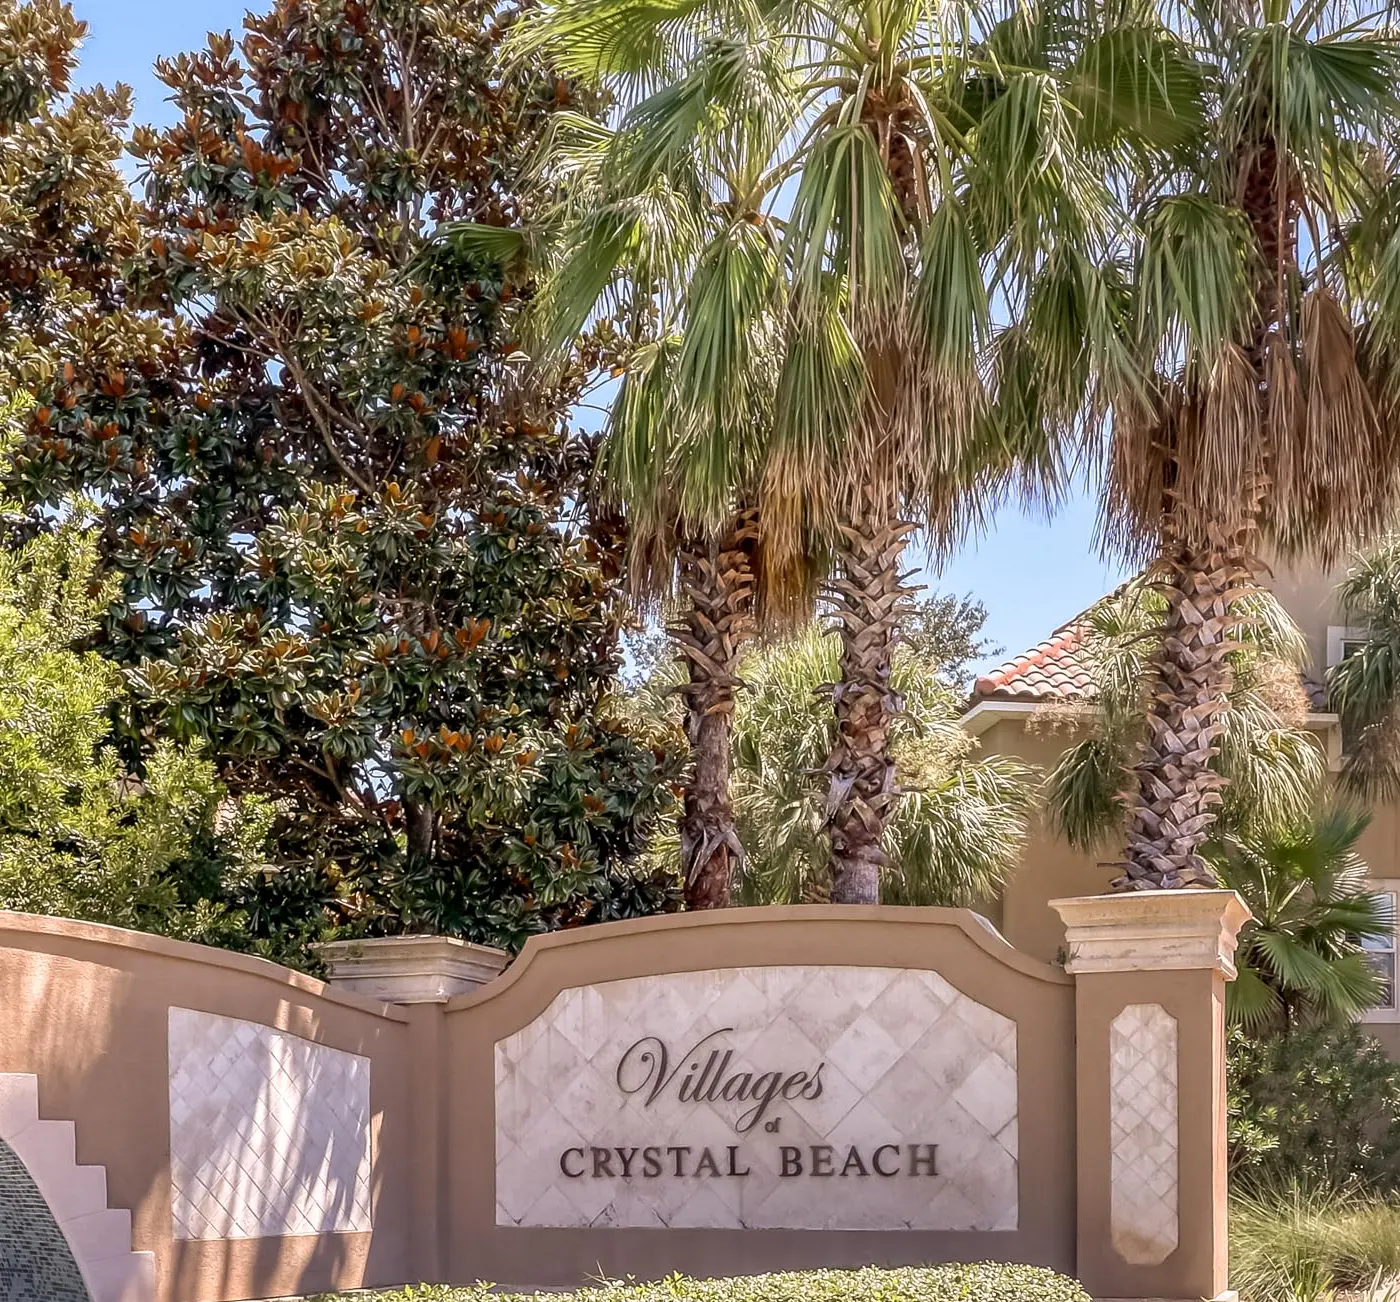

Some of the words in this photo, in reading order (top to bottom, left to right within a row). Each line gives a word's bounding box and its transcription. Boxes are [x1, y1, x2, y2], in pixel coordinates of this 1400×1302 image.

[616, 1028, 825, 1133] Villages
[764, 1116, 783, 1134] of
[559, 1145, 750, 1179] CRYSTAL
[778, 1143, 940, 1177] BEACH
